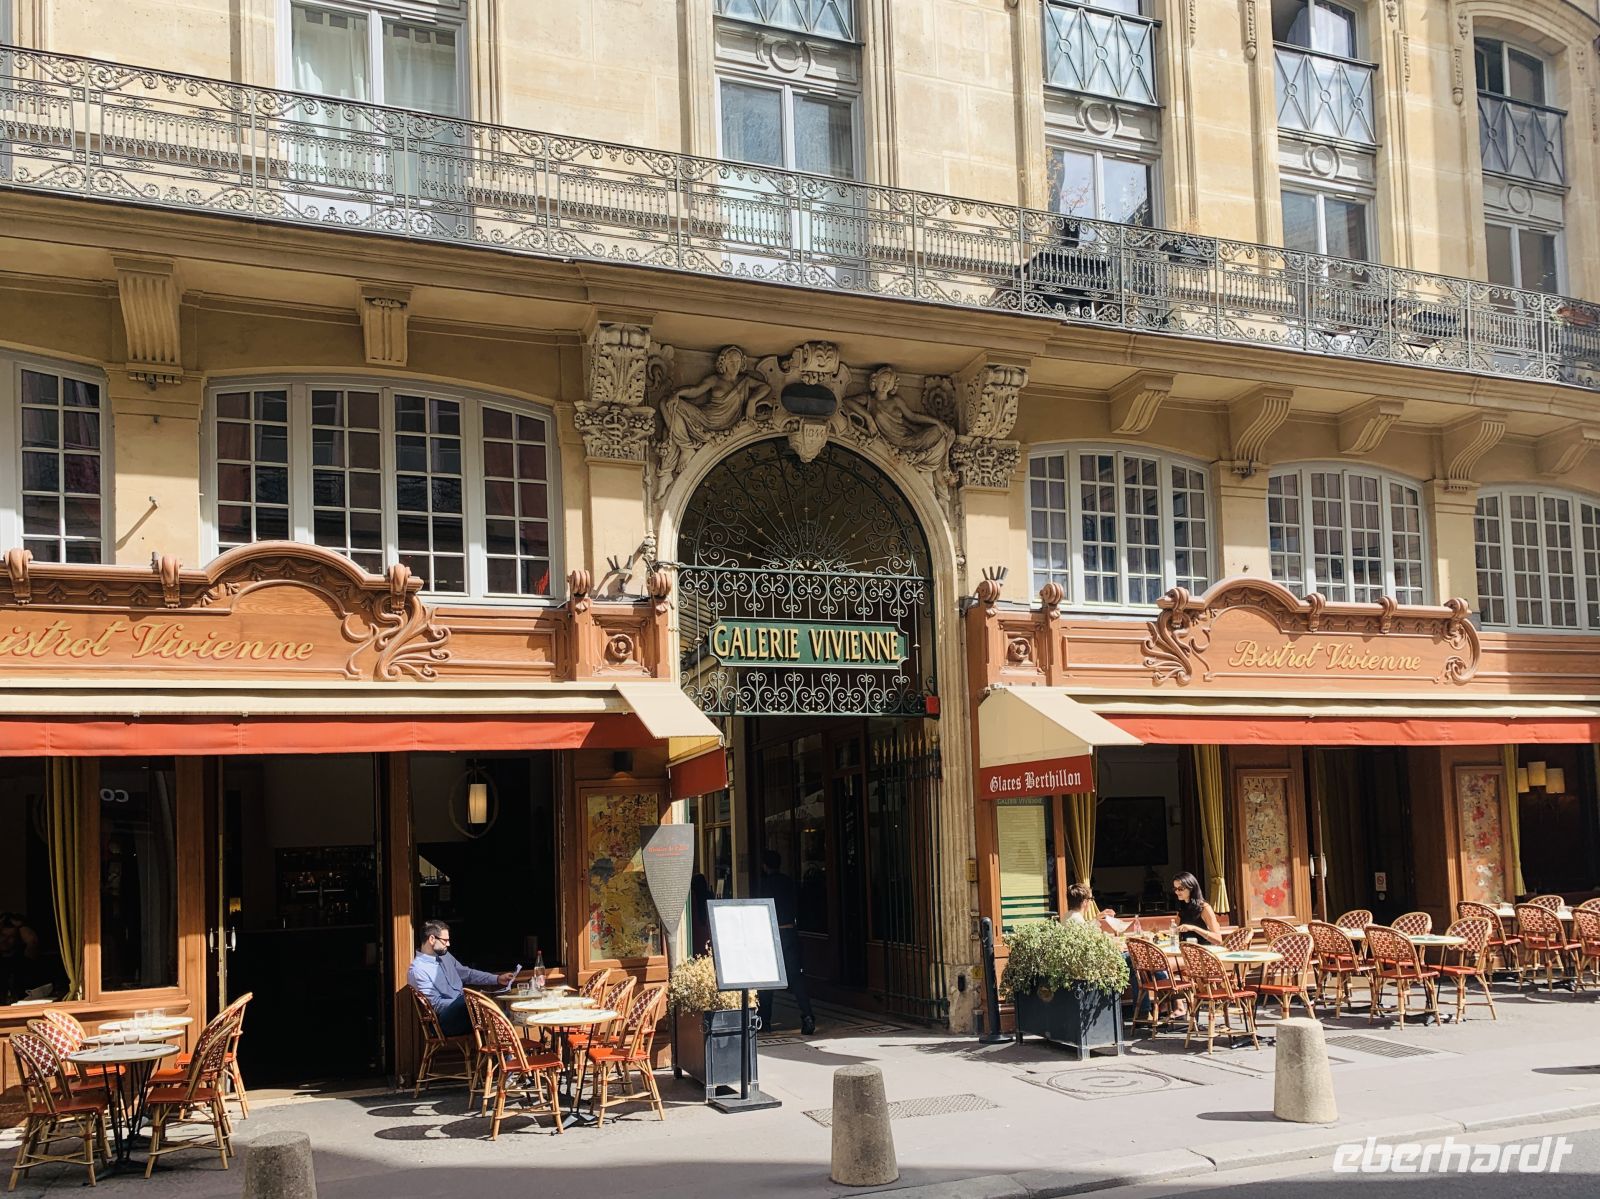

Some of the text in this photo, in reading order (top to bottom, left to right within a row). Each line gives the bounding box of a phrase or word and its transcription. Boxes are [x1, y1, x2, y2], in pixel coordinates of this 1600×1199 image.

[0, 619, 314, 661] istrot Vivienne
[713, 625, 901, 662] GALERIE VIVIENNE
[1228, 639, 1422, 671] Bistrot Vivienne
[989, 769, 1082, 793] Glaces Berthillon
